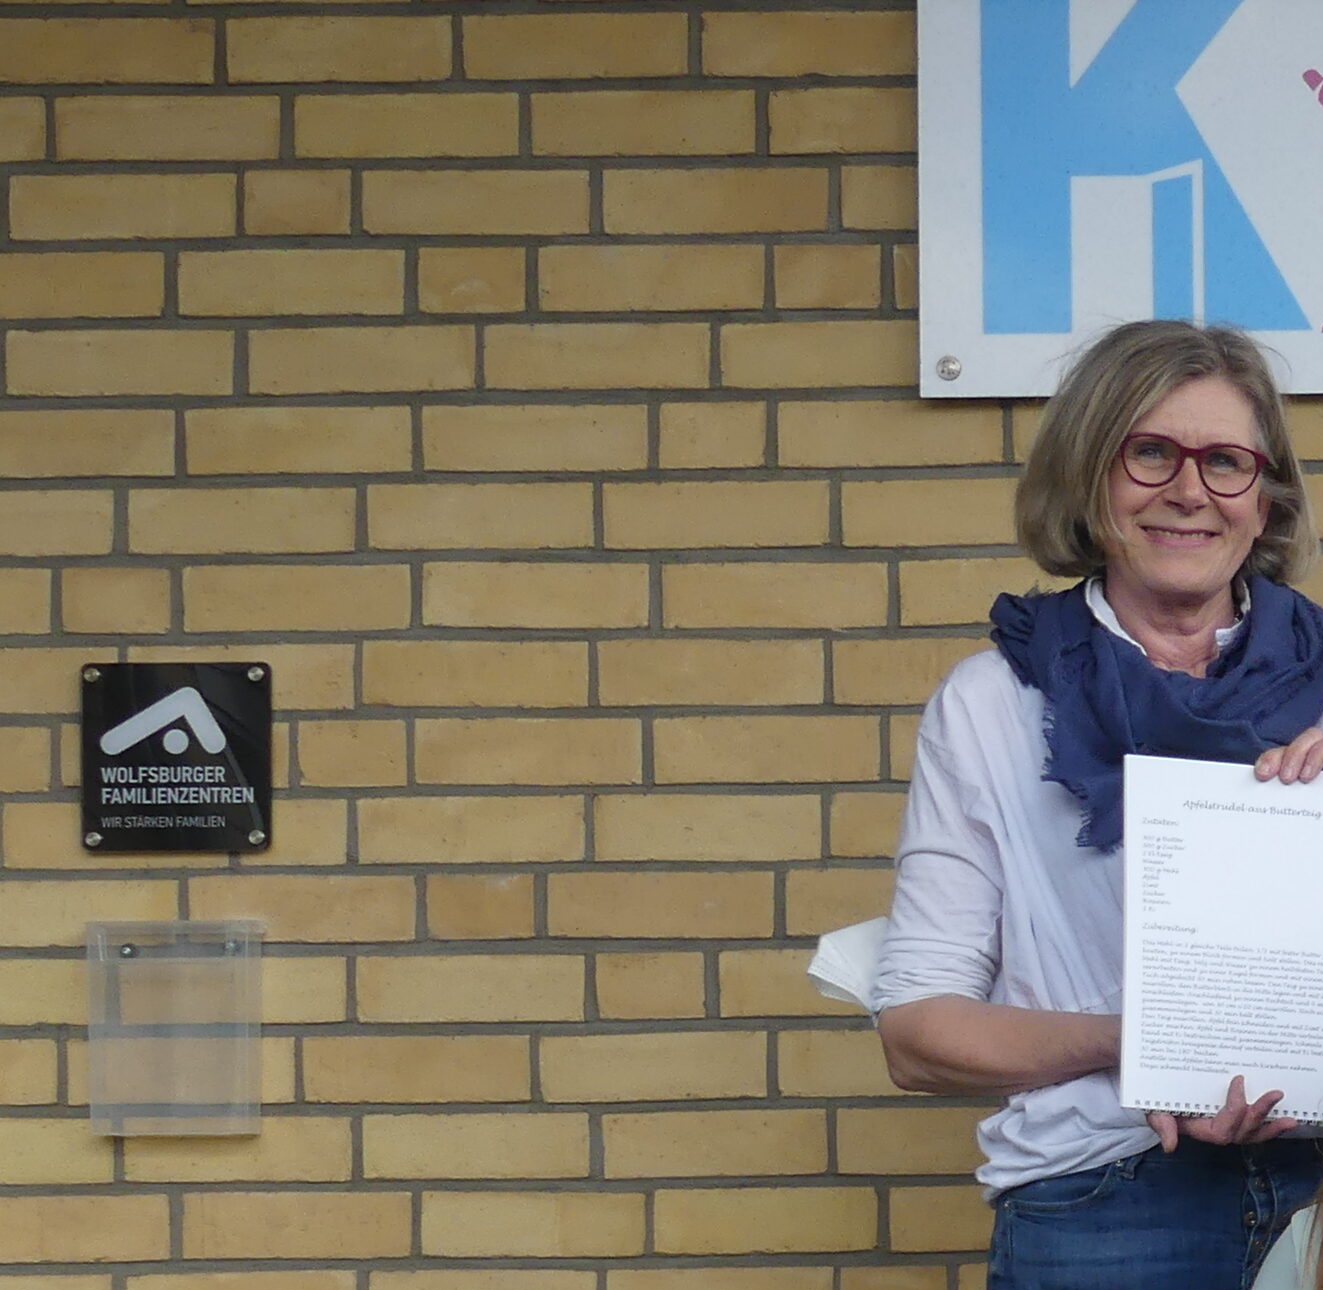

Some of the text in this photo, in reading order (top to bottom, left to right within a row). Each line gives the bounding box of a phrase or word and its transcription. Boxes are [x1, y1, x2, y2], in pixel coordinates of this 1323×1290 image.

[100, 766, 226, 783] WOLFSBURGER
[101, 786, 255, 804] FAMILIENZENTREN
[1182, 799, 1245, 813] Apfelstrudel
[101, 815, 226, 828] WIR STÄRKEN FAMILIEN
